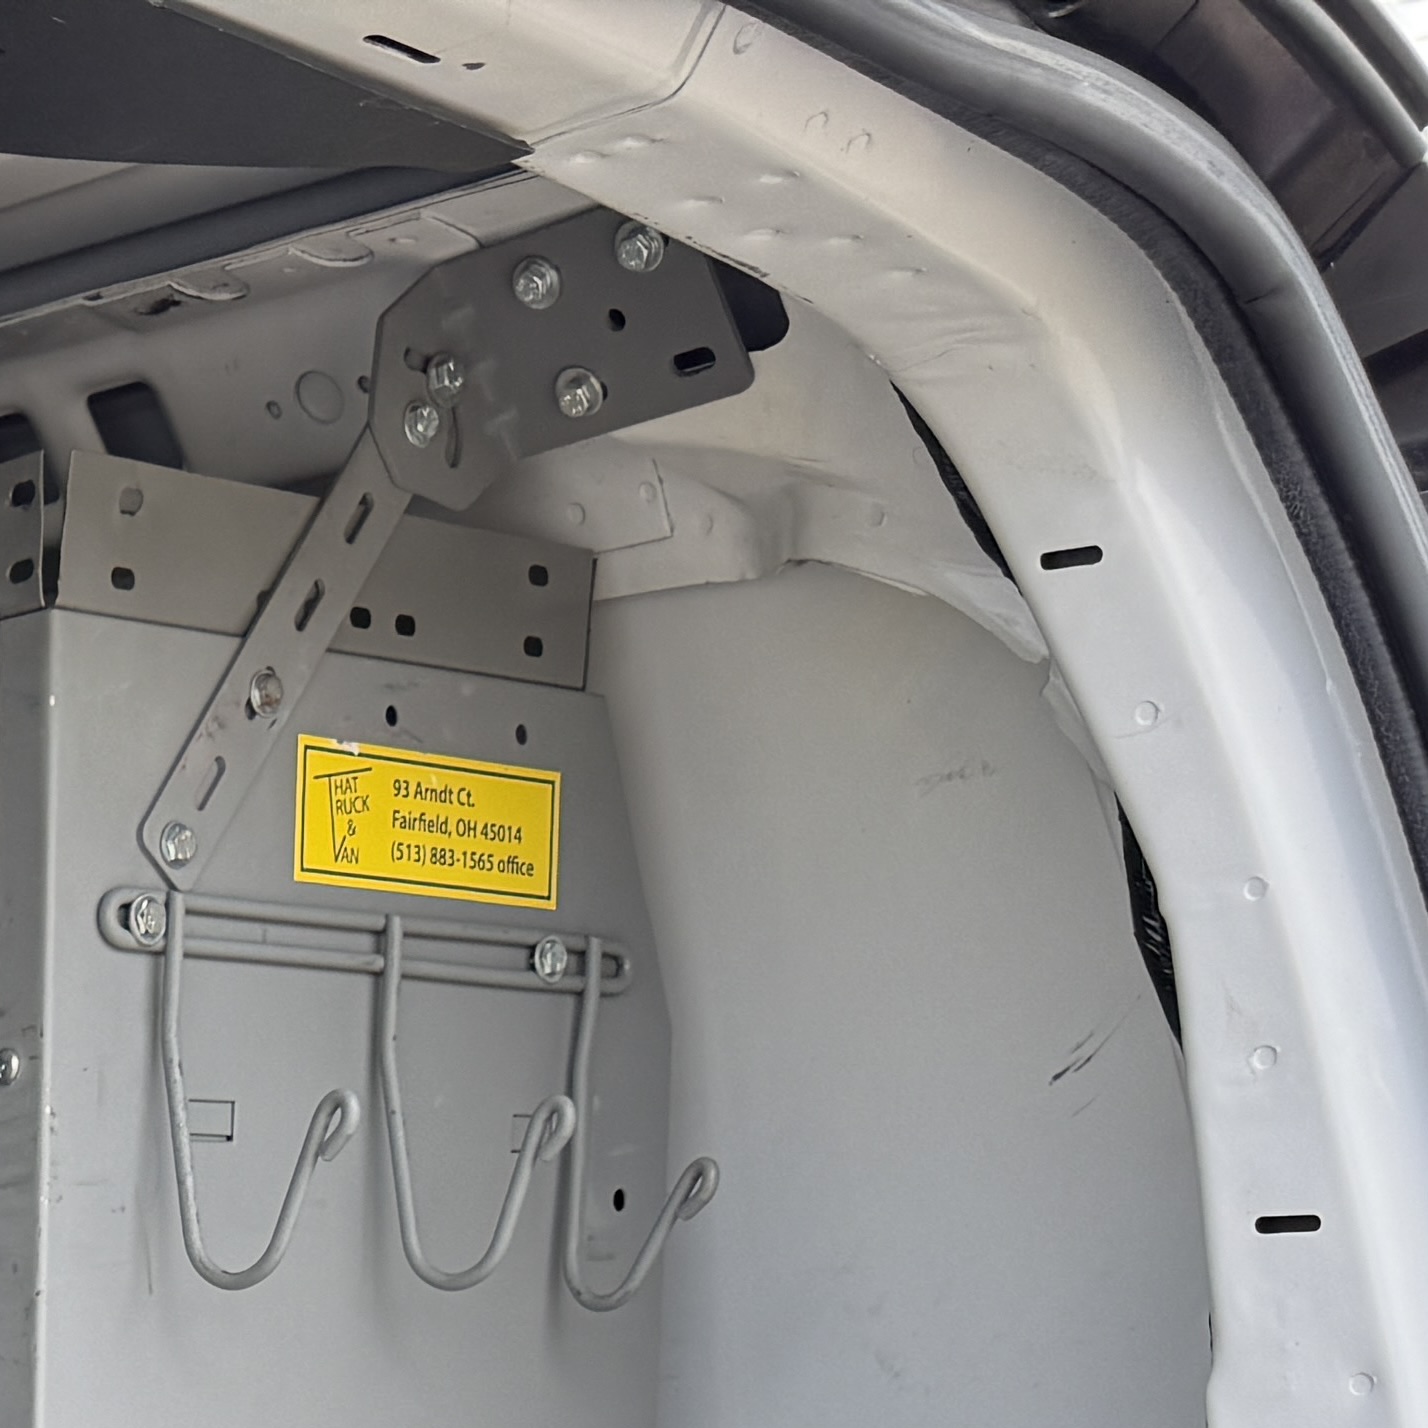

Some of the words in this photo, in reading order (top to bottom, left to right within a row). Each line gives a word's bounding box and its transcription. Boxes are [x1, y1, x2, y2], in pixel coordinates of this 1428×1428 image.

[393, 778, 410, 798] 93
[414, 781, 454, 804] Arndt
[456, 787, 476, 808] Ct.
[347, 819, 357, 836] &
[392, 809, 452, 838] Fairfield,
[455, 818, 477, 840] OH
[480, 822, 523, 844] 45014
[391, 840, 427, 867] (513)
[429, 847, 494, 871] 883-1565
[497, 855, 535, 878] office
